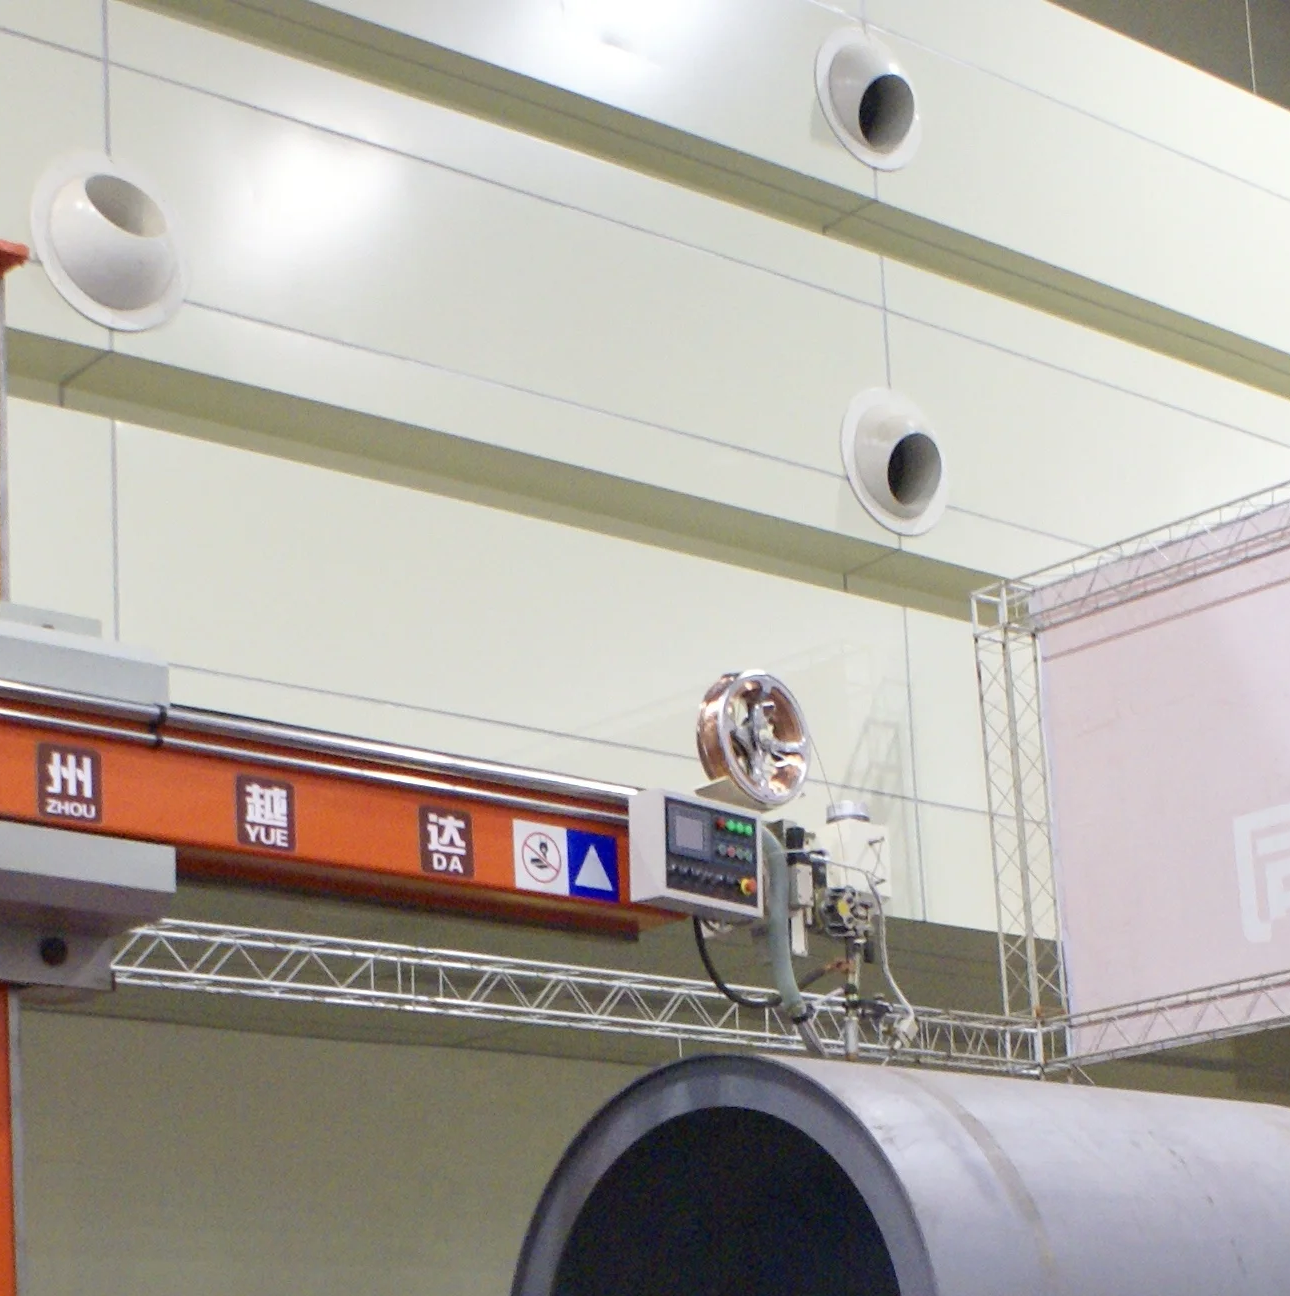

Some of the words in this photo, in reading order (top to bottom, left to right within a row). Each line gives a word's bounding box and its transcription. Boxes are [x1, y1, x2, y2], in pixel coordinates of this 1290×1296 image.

[46, 799, 96, 819] ZHOU
[244, 824, 289, 848] YUE
[432, 853, 464, 874] DA
[47, 752, 92, 798] 州
[426, 813, 466, 854] 达
